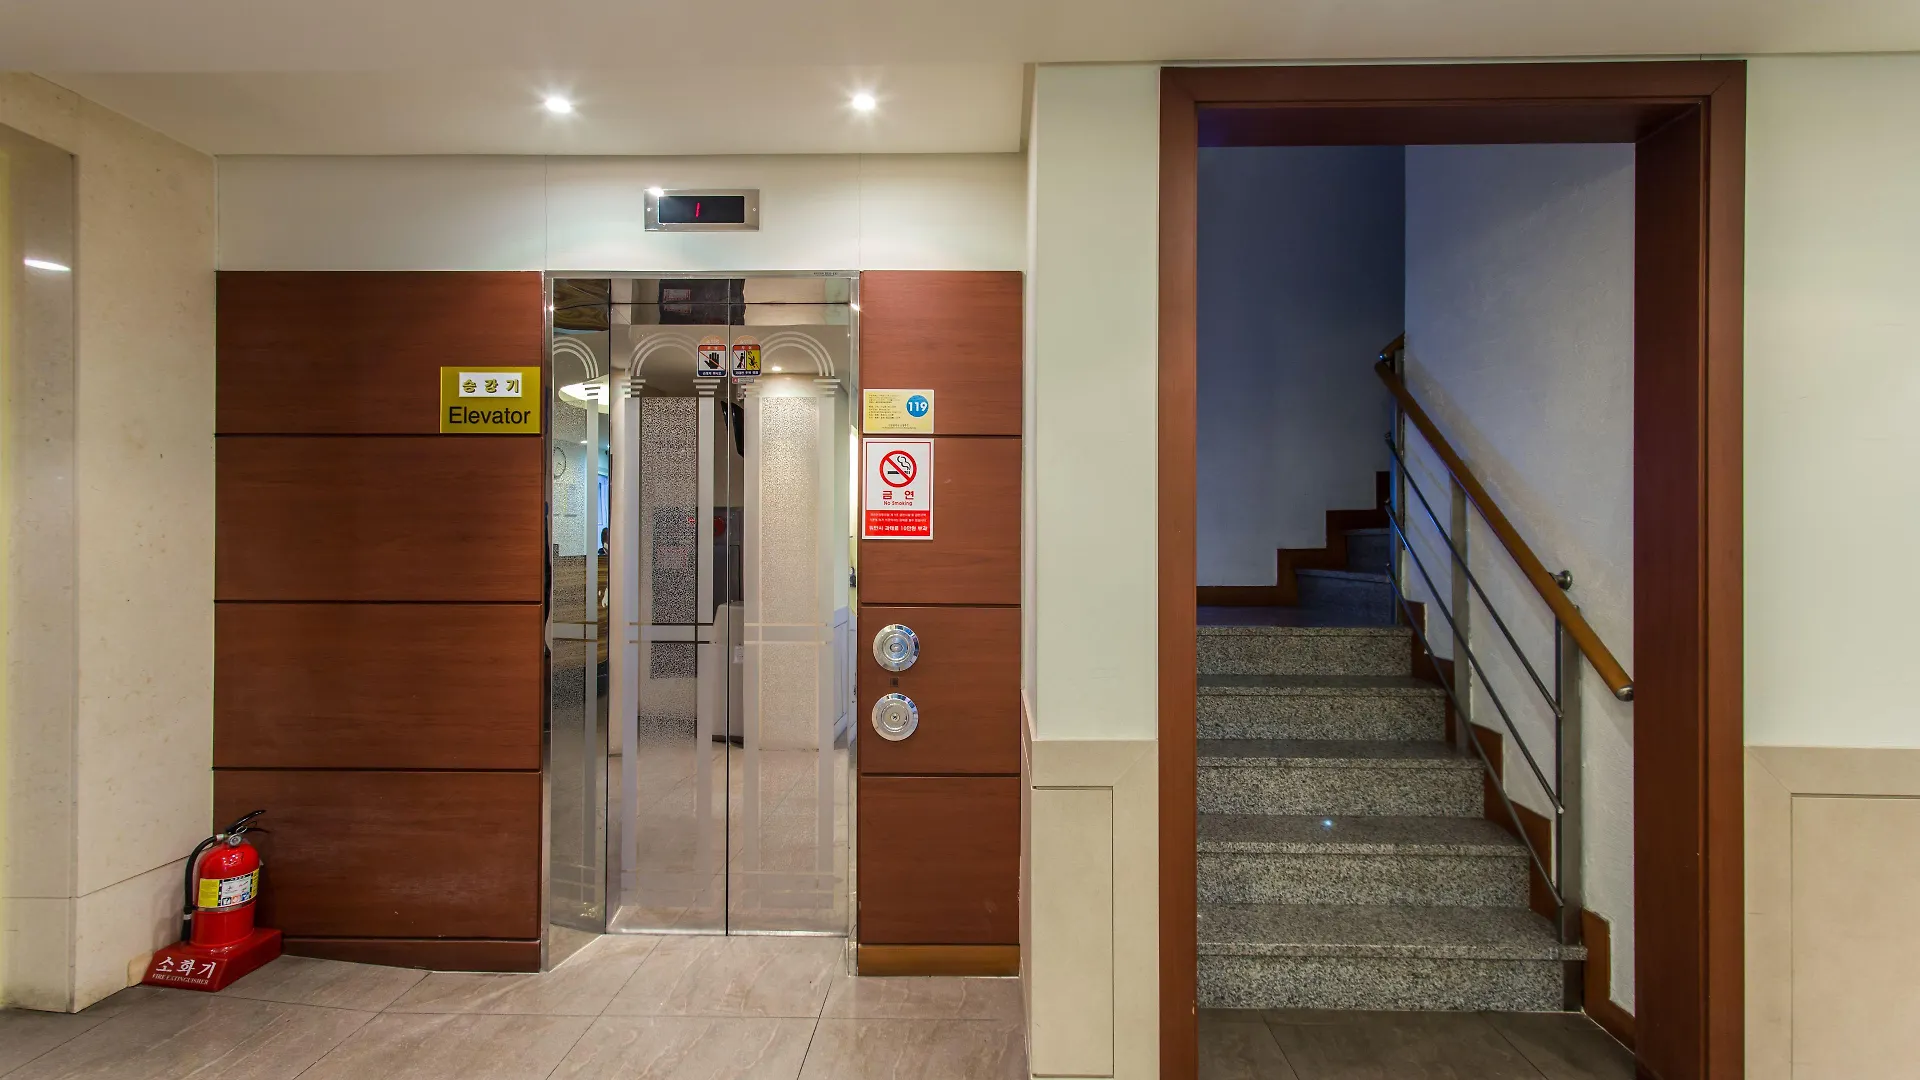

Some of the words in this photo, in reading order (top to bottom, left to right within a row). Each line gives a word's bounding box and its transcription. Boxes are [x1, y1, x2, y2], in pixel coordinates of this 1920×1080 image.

[908, 401, 928, 412] 119
[449, 406, 531, 424] Elevator
[155, 956, 217, 979] 소화기
[166, 974, 209, 985] EXTINGUISHER
